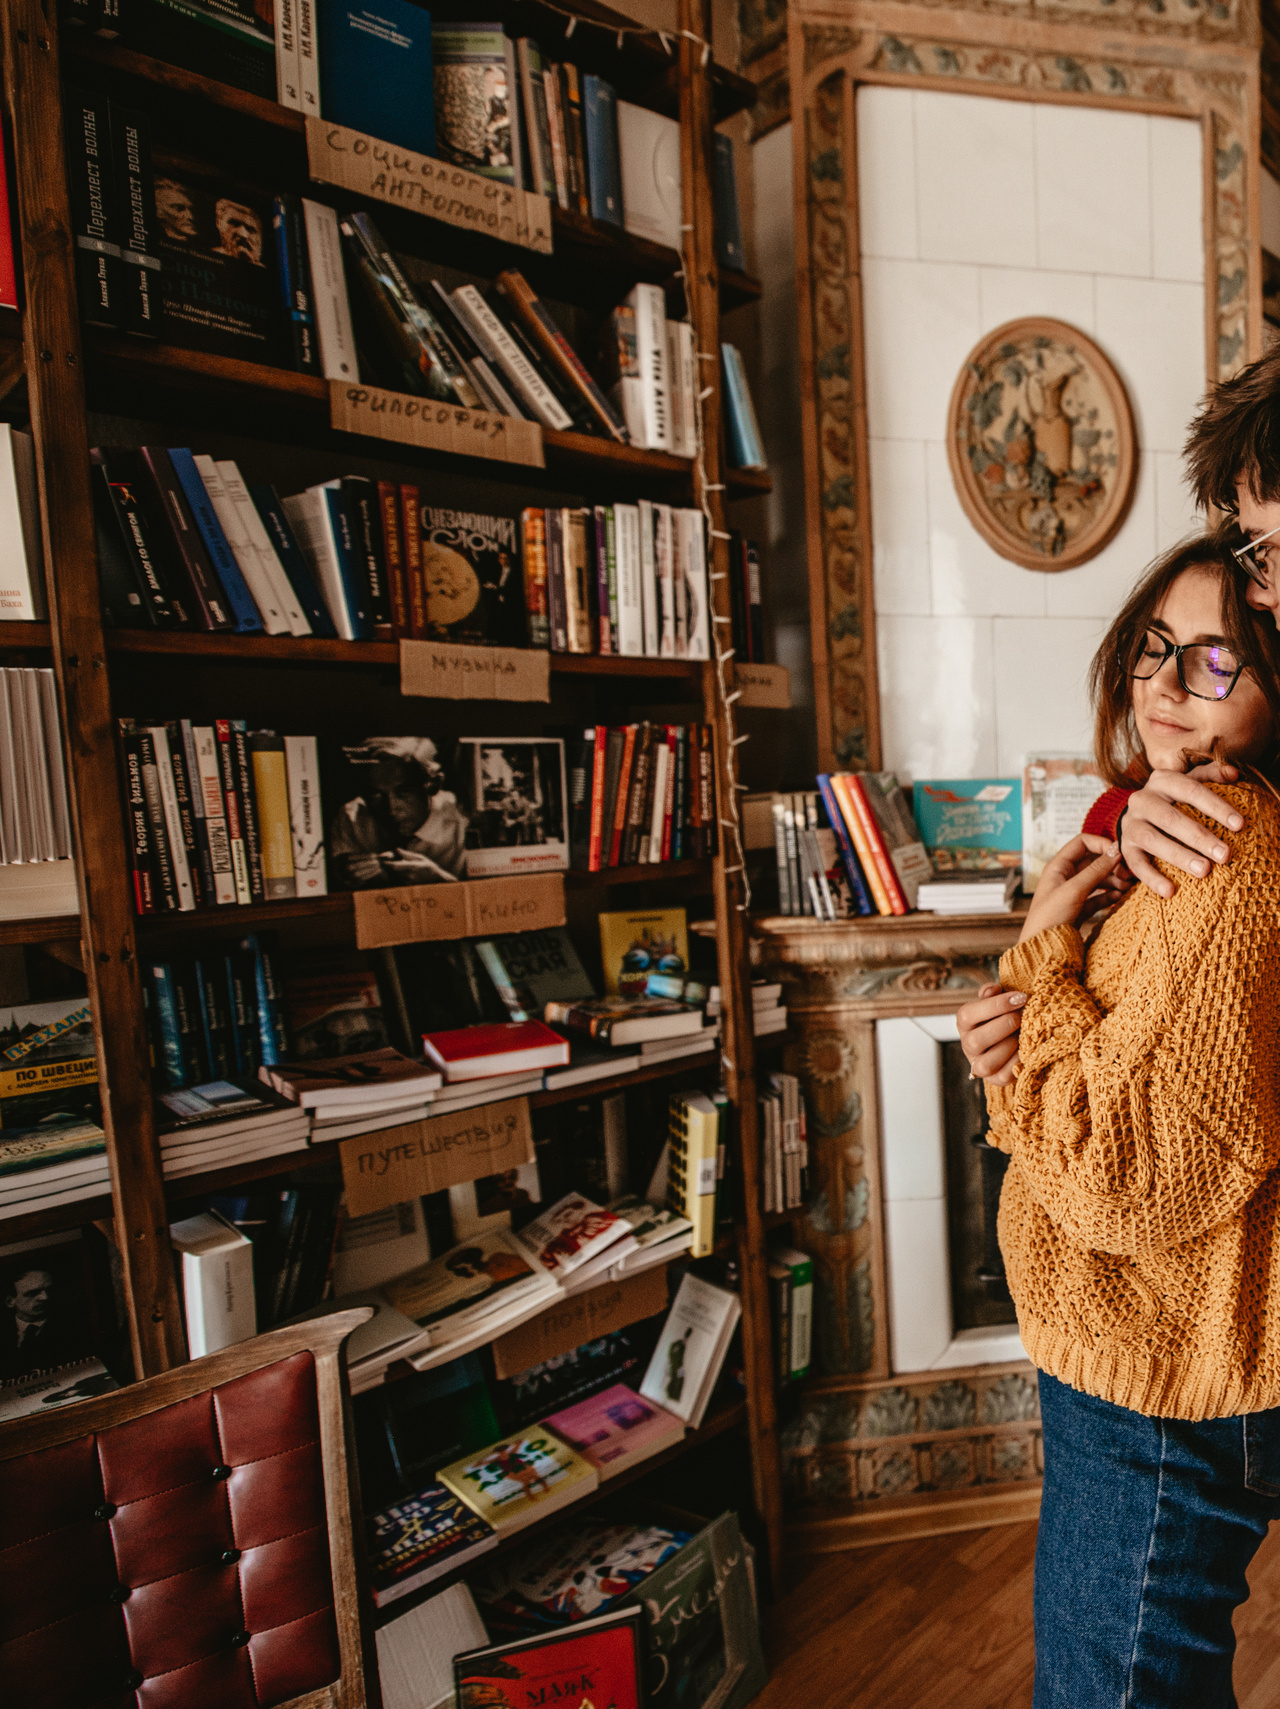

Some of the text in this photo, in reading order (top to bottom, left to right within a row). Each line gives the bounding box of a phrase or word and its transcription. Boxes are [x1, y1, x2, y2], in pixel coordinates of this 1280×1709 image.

[82, 108, 105, 238] Перехлест волны
[125, 126, 146, 252] Перехлест волны
[1, 600, 22, 608] Баха
[432, 653, 516, 675] МУЗЫКА
[128, 753, 149, 855] Теория фильмов
[172, 753, 196, 850] Теория фильмов
[6, 1007, 91, 1058] ПЕХАЛИ
[16, 1060, 97, 1081] ПО ШВЕЦИ
[358, 1115, 517, 1175] ПУТЕШЕСТВИЯ
